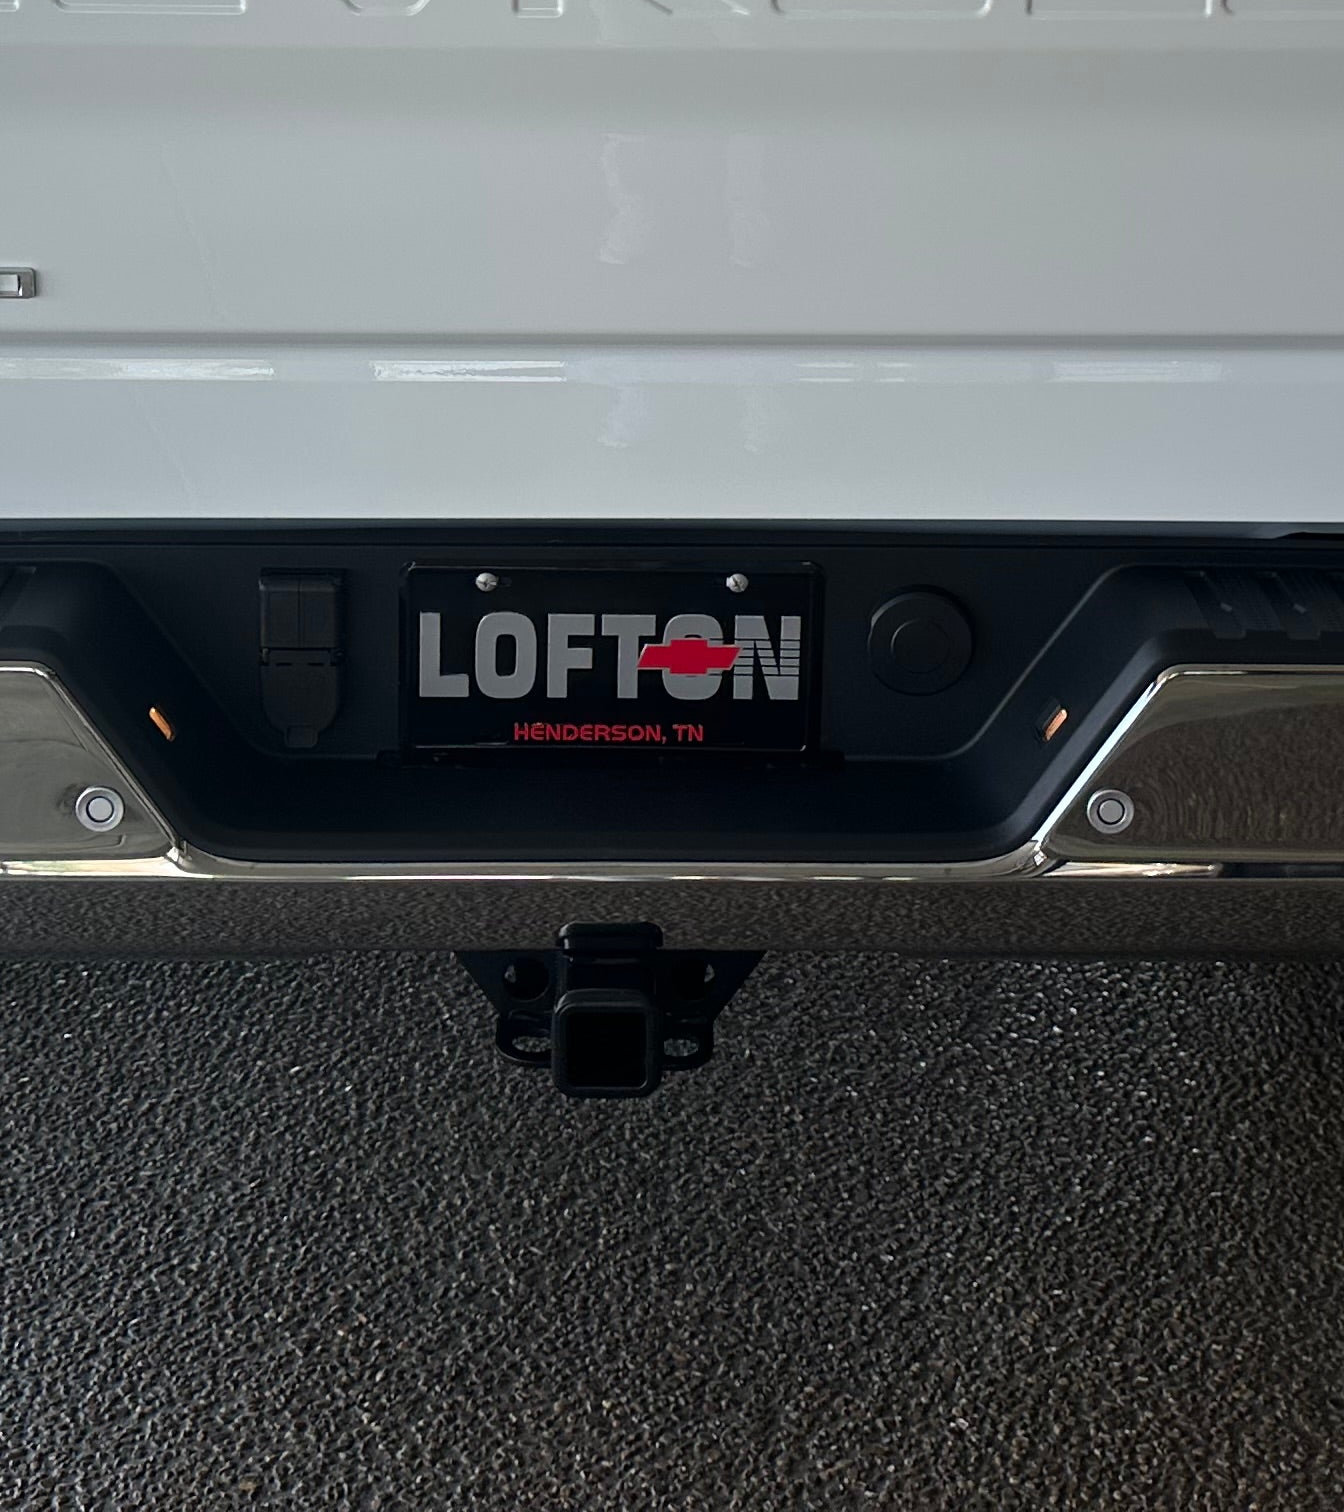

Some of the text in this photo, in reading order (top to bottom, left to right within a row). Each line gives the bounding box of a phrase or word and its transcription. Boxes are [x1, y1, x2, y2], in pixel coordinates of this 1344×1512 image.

[419, 611, 801, 700] LOFTON
[513, 722, 704, 744] HENDERSON, TN
